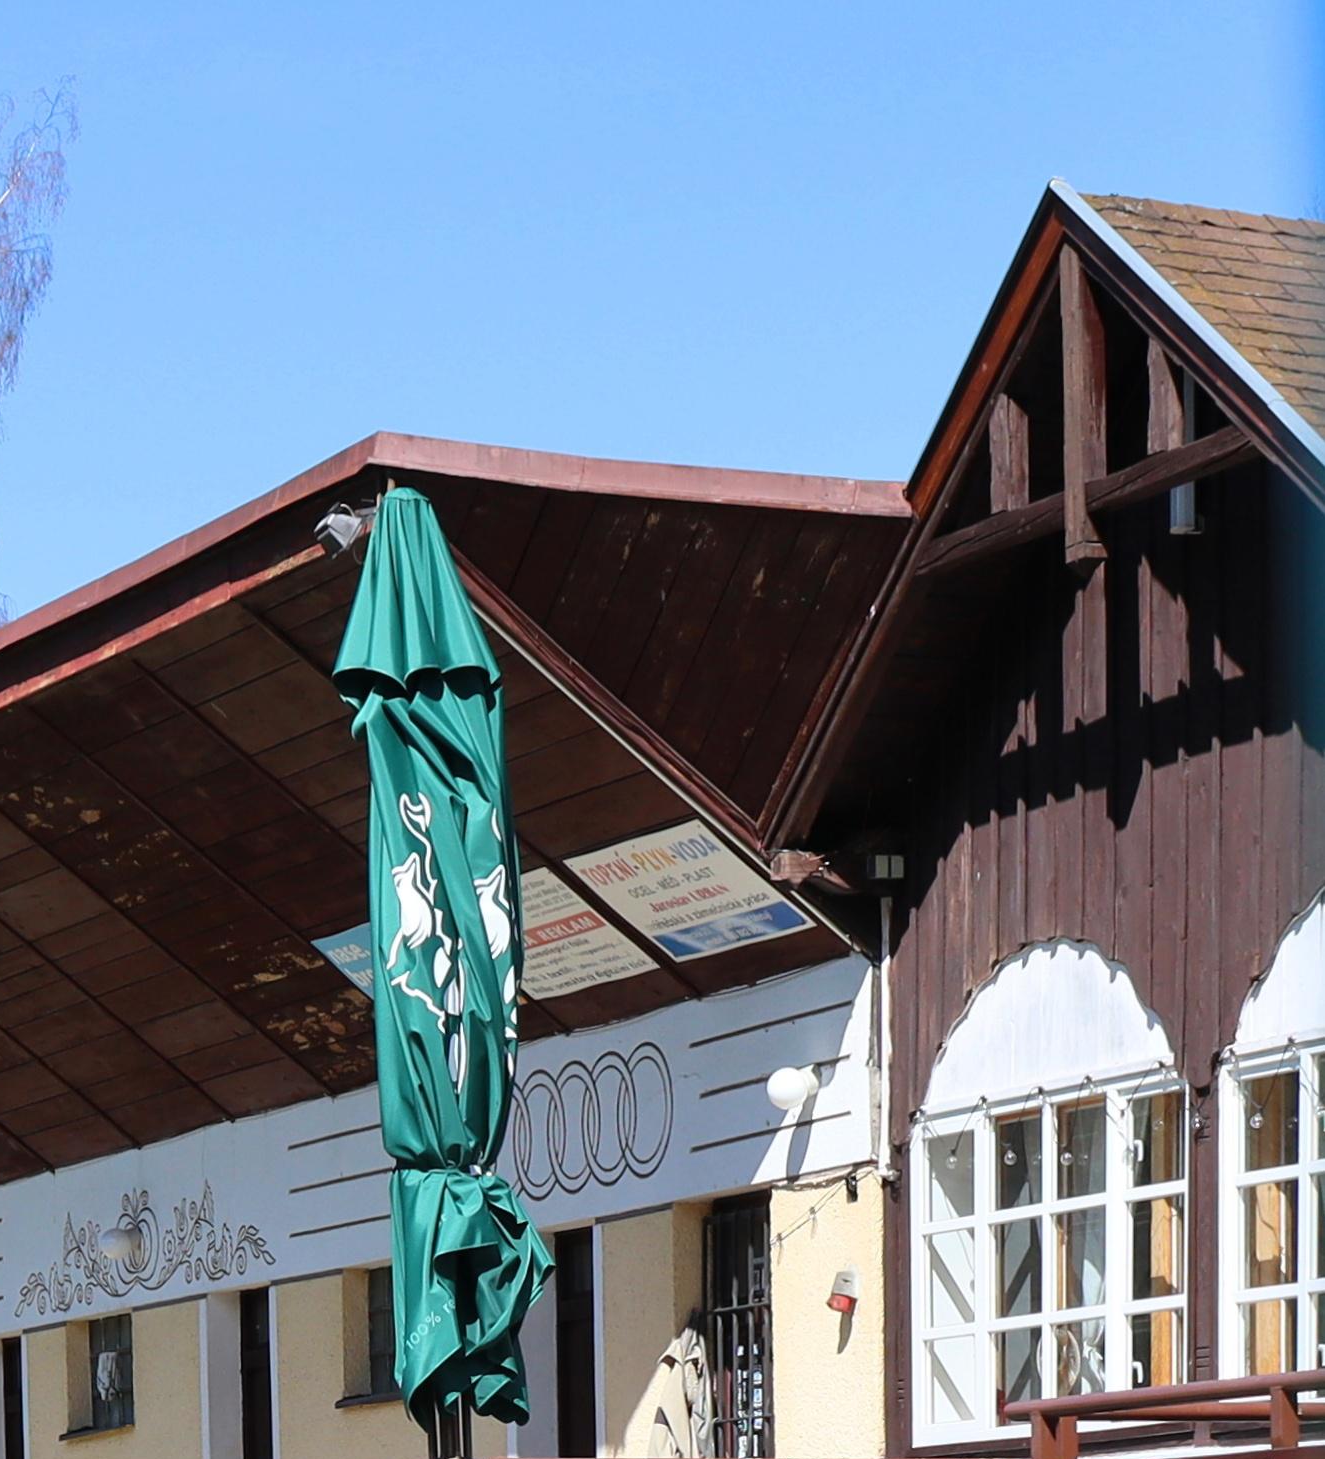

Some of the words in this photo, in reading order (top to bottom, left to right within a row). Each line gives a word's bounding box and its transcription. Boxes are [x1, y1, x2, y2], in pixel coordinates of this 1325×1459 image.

[669, 834, 721, 862] VODA
[538, 916, 598, 942] REKLAM
[405, 1311, 442, 1351] 100%
